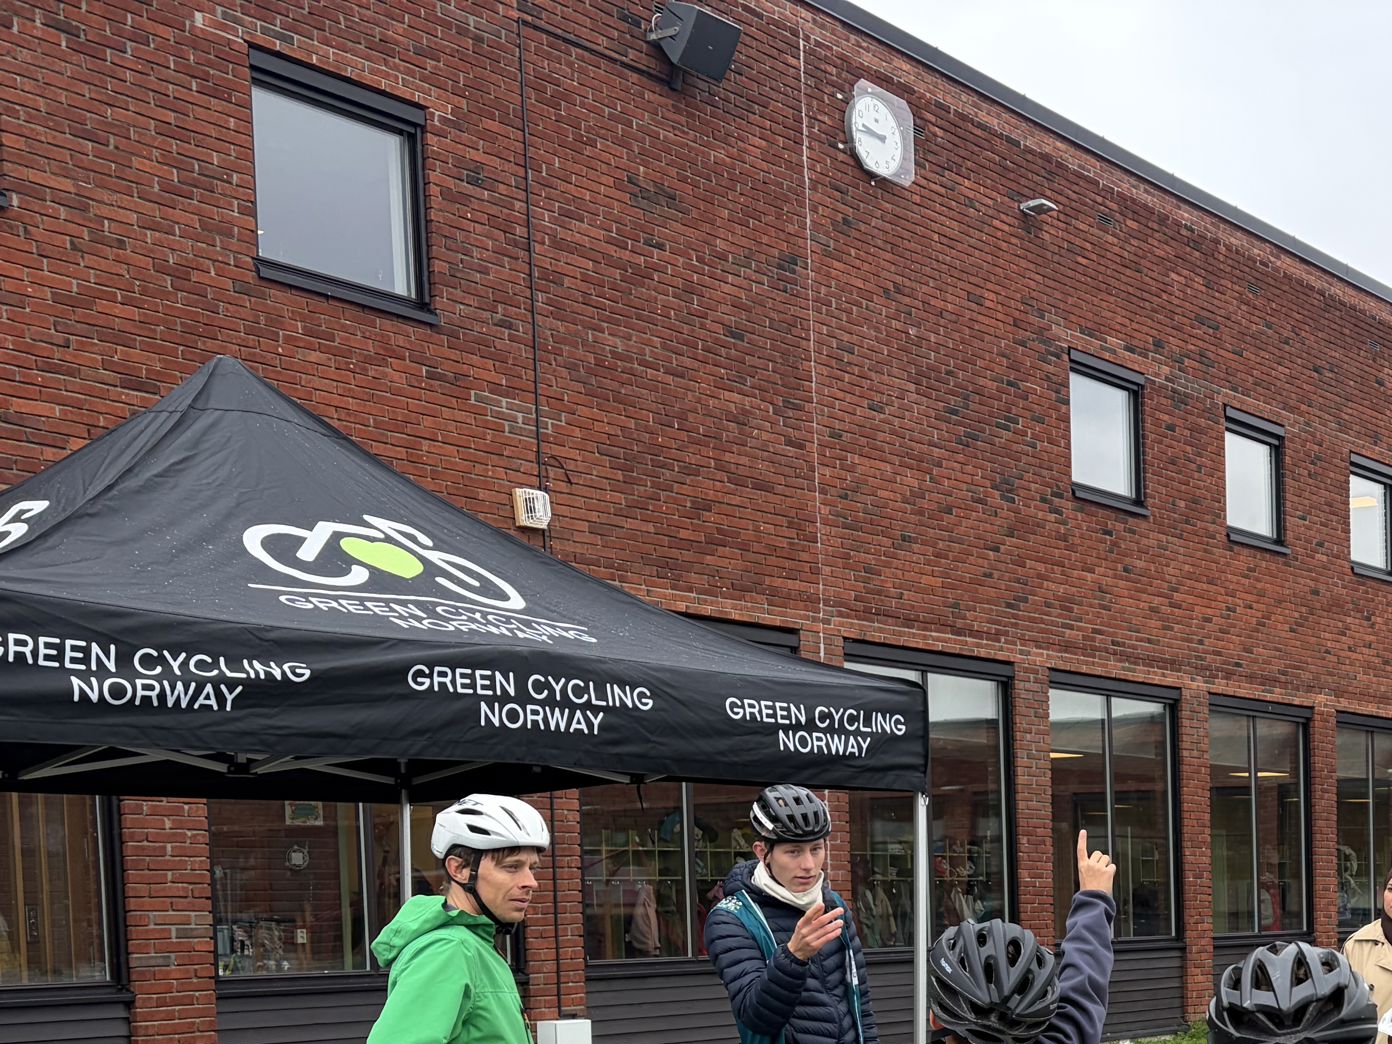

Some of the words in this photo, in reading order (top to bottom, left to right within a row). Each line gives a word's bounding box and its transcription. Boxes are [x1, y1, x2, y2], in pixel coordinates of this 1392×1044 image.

[278, 594, 427, 618] GREEN
[435, 605, 598, 643] CYCLING
[389, 616, 553, 644] NORWAY
[0, 633, 116, 672] REEN
[133, 648, 311, 682] CYCLING
[71, 675, 243, 711] NORWAY
[407, 664, 515, 696] GREEN
[527, 674, 653, 710] CYCLING
[480, 701, 604, 736] NORWAY
[725, 697, 806, 727] GREEN
[814, 706, 906, 736] CYCLING
[778, 730, 871, 758] NORWAY
